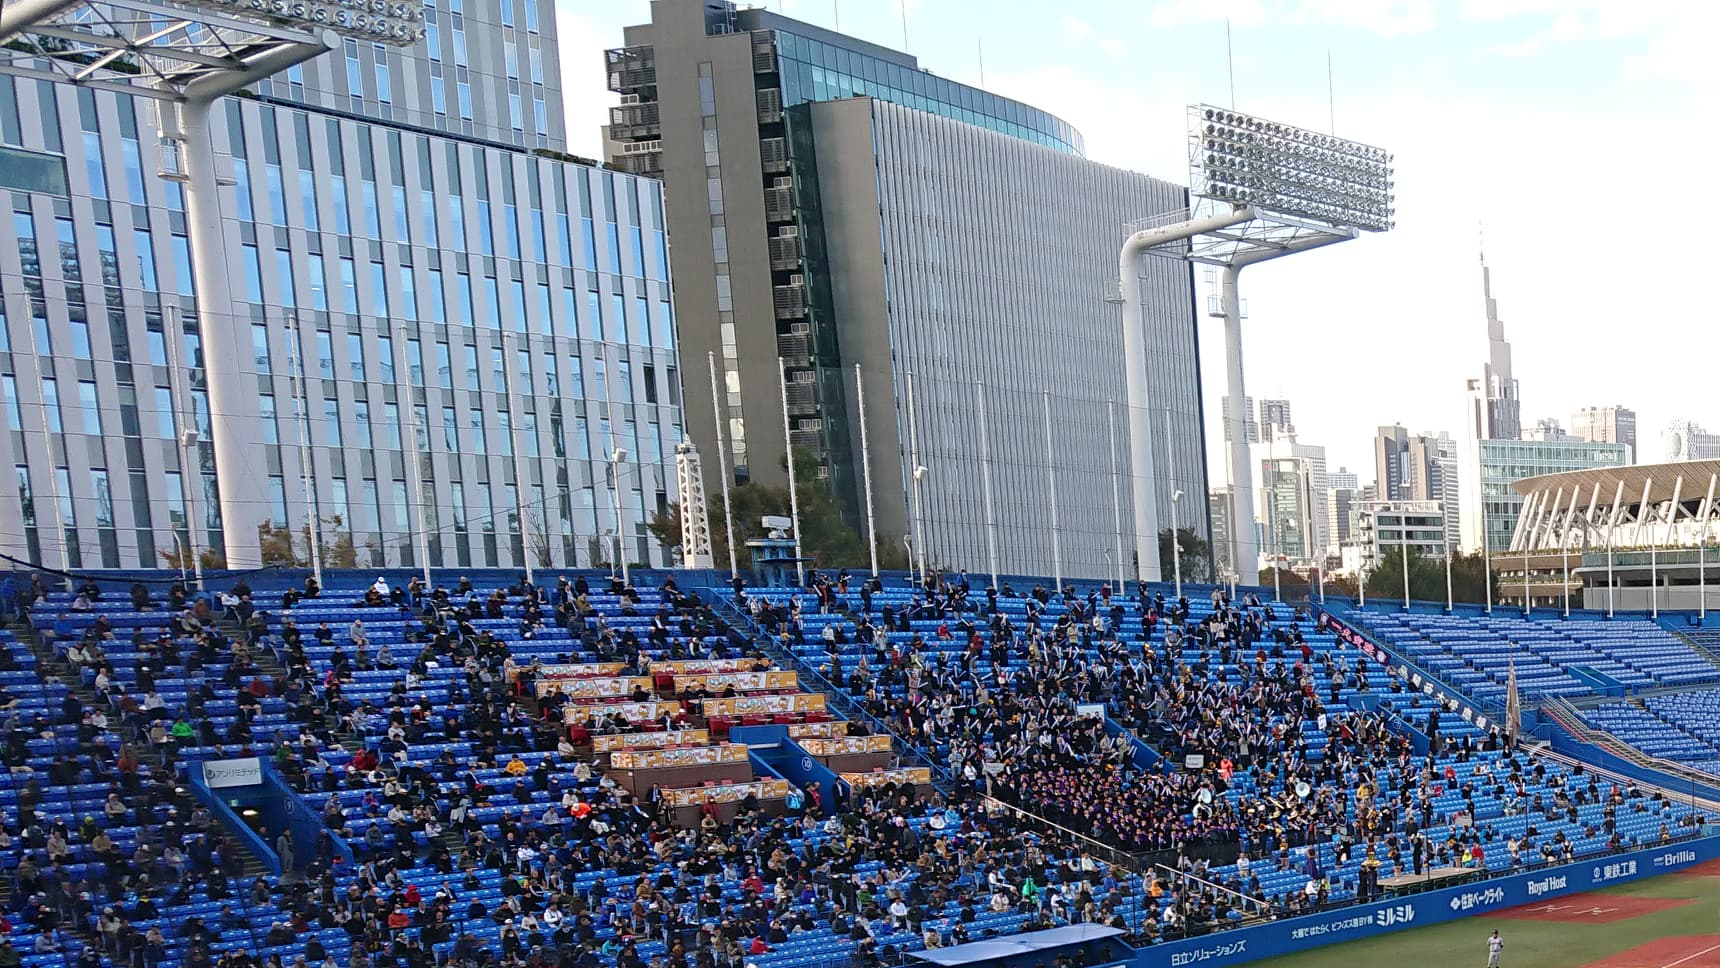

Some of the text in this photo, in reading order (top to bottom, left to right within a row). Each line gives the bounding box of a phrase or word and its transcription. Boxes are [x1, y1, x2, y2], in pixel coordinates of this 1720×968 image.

[1664, 850, 1696, 866] Brillia
[1603, 859, 1638, 881] 東鉄工業
[1527, 874, 1567, 896] Royal Host
[1460, 886, 1505, 910] 住友ベークライト
[1376, 904, 1416, 926] ミルミル
[1171, 939, 1247, 967] 日立ソリューションズ
